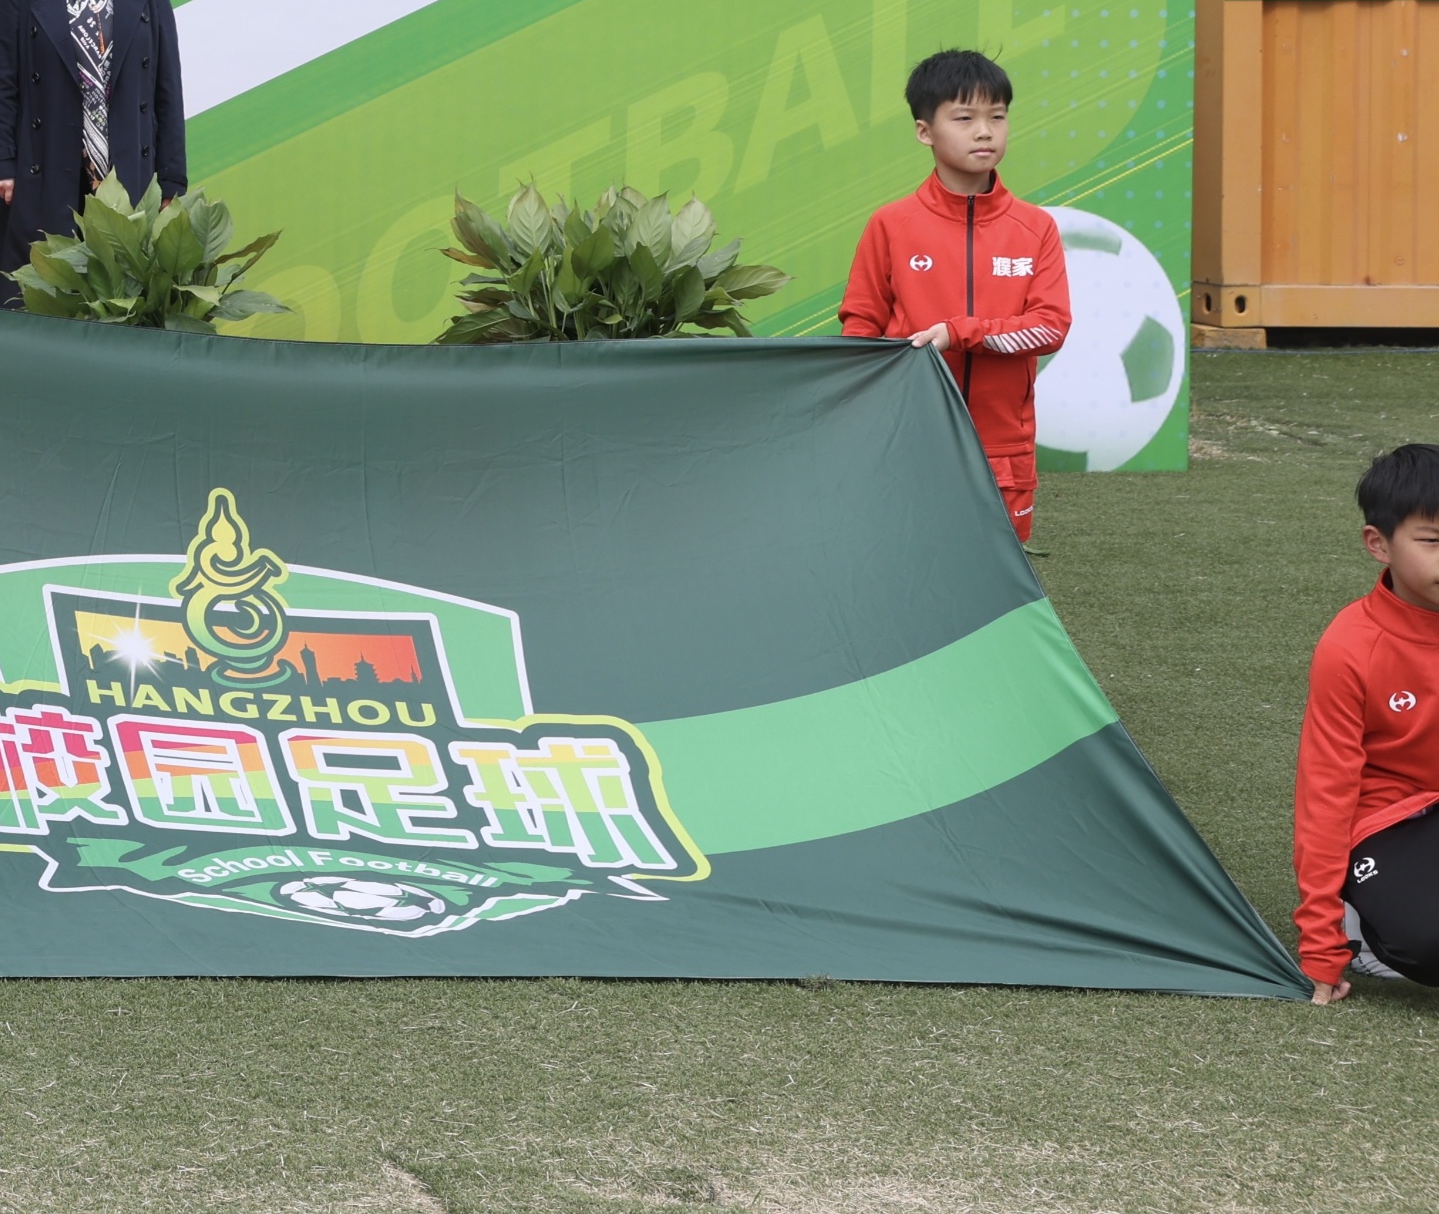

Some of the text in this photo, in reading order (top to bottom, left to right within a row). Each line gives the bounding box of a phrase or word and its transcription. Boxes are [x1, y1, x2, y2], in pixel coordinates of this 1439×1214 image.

[992, 256, 1034, 277] 濮家
[87, 677, 437, 728] HANGZHOU
[177, 848, 499, 887] School Football
